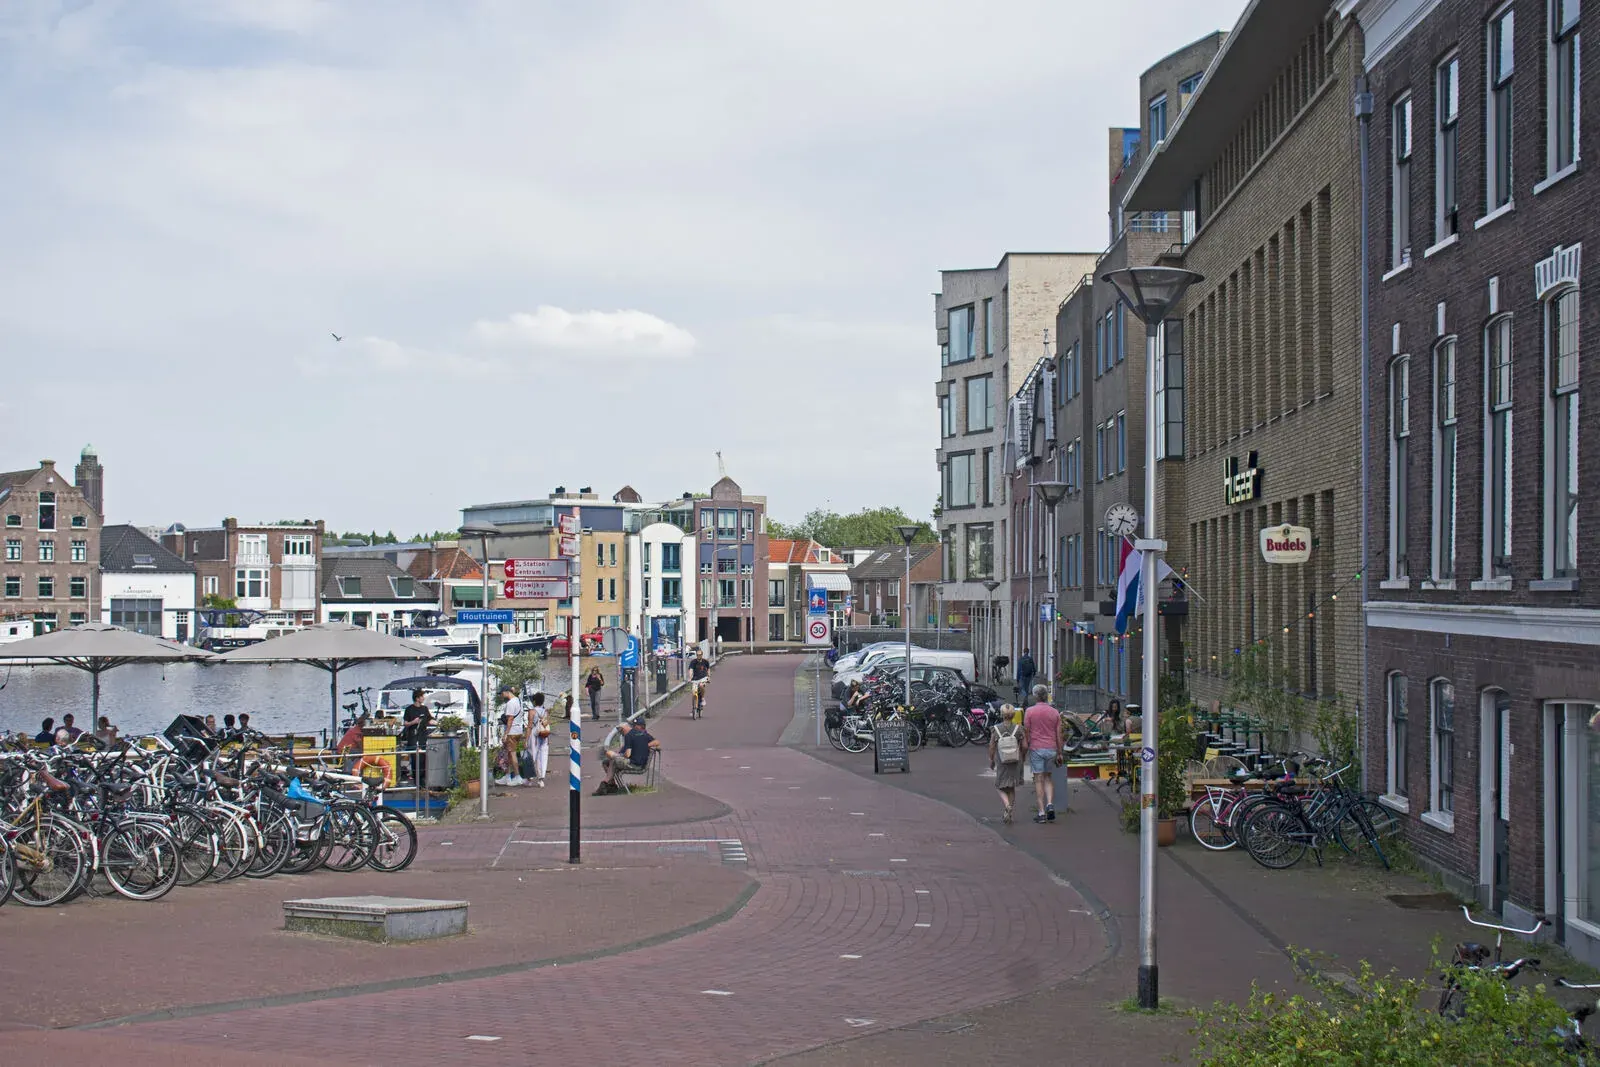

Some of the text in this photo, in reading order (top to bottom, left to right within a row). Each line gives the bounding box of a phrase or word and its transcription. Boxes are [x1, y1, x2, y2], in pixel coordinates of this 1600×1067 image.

[1266, 538, 1307, 551] Budels
[462, 612, 508, 620] Houttuinen
[813, 626, 824, 634] 30
